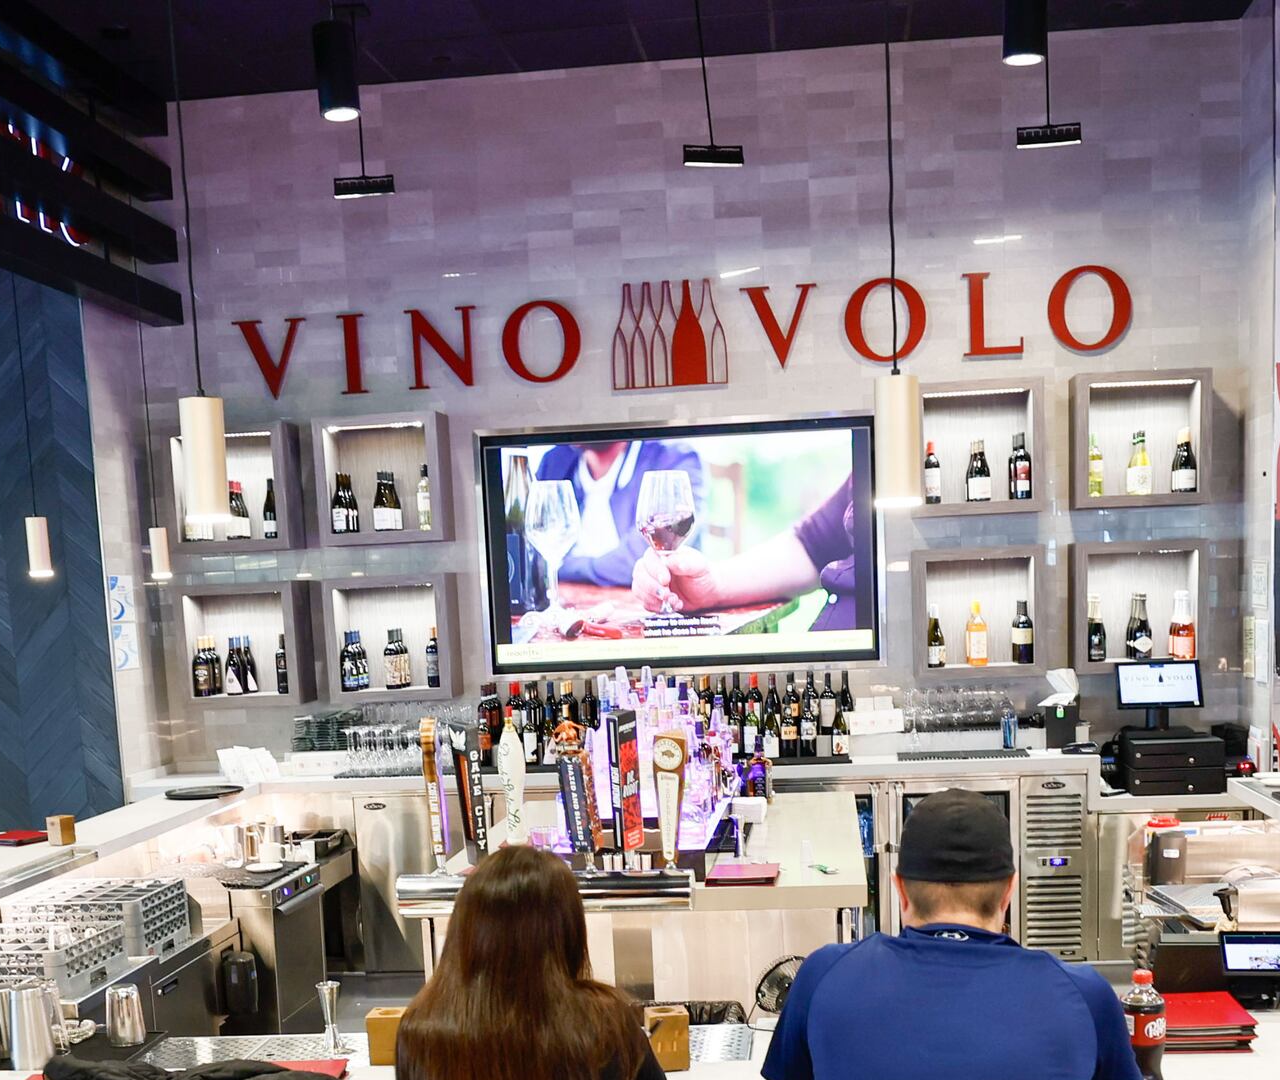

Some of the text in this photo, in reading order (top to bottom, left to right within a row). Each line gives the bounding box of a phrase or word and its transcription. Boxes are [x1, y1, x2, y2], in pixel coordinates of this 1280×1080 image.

[230, 263, 1134, 400] VINO VOLO
[470, 750, 487, 850] GATE CITY
[571, 792, 579, 810] AND
[574, 811, 583, 841] BLAZED
